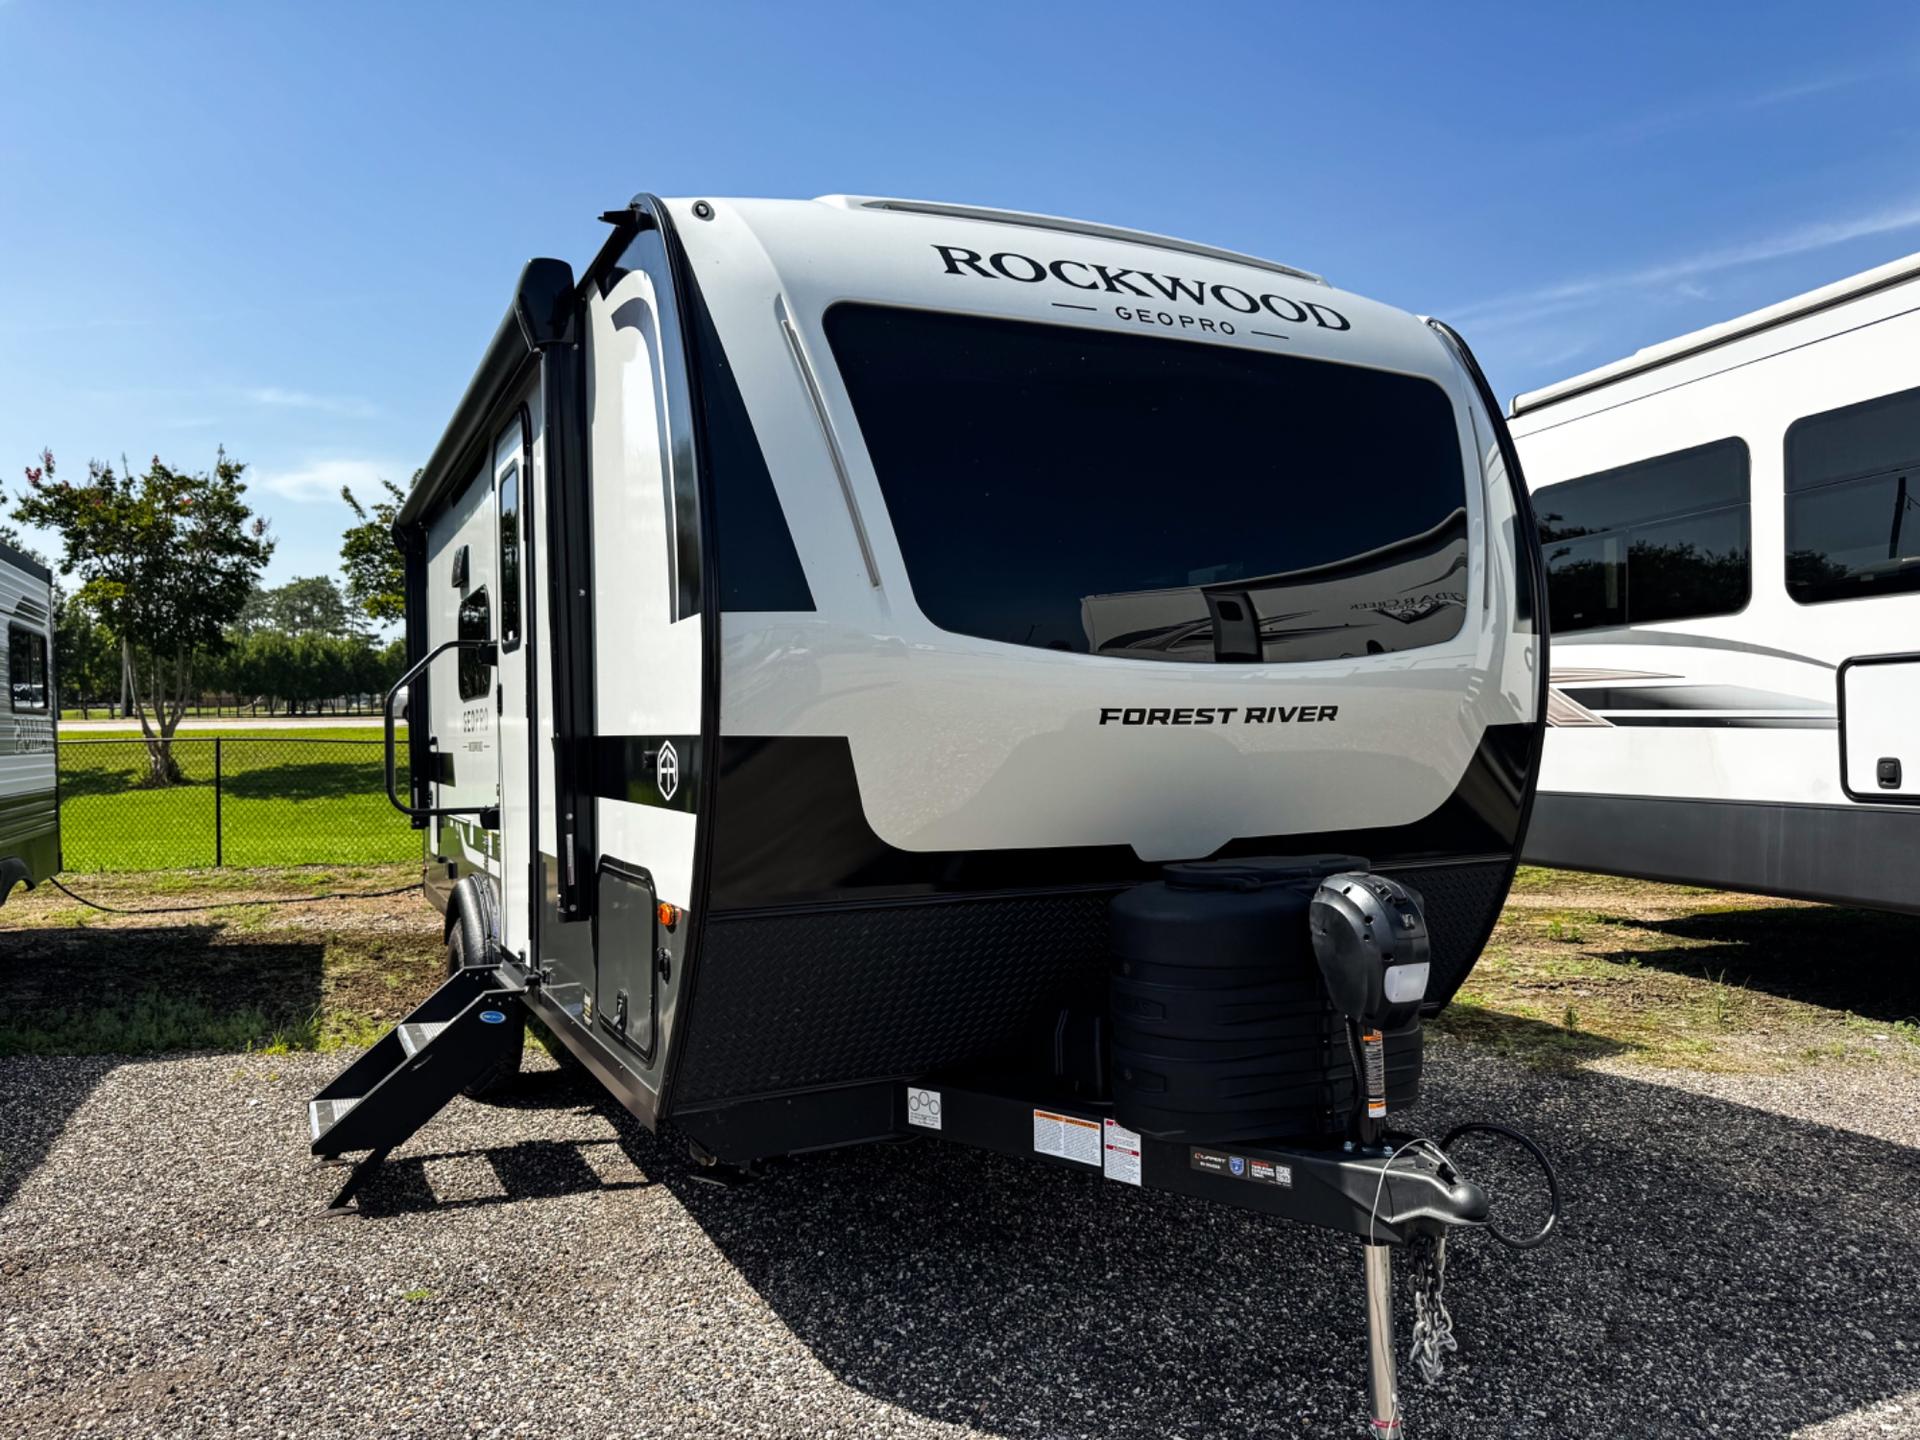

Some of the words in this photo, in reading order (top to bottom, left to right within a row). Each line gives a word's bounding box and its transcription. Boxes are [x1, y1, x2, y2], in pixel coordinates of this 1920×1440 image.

[930, 244, 1350, 331] ROCKWOOD
[1114, 305, 1235, 335] GEOPRO
[1099, 707, 1238, 726] FOREST
[1244, 705, 1339, 724] RIVER
